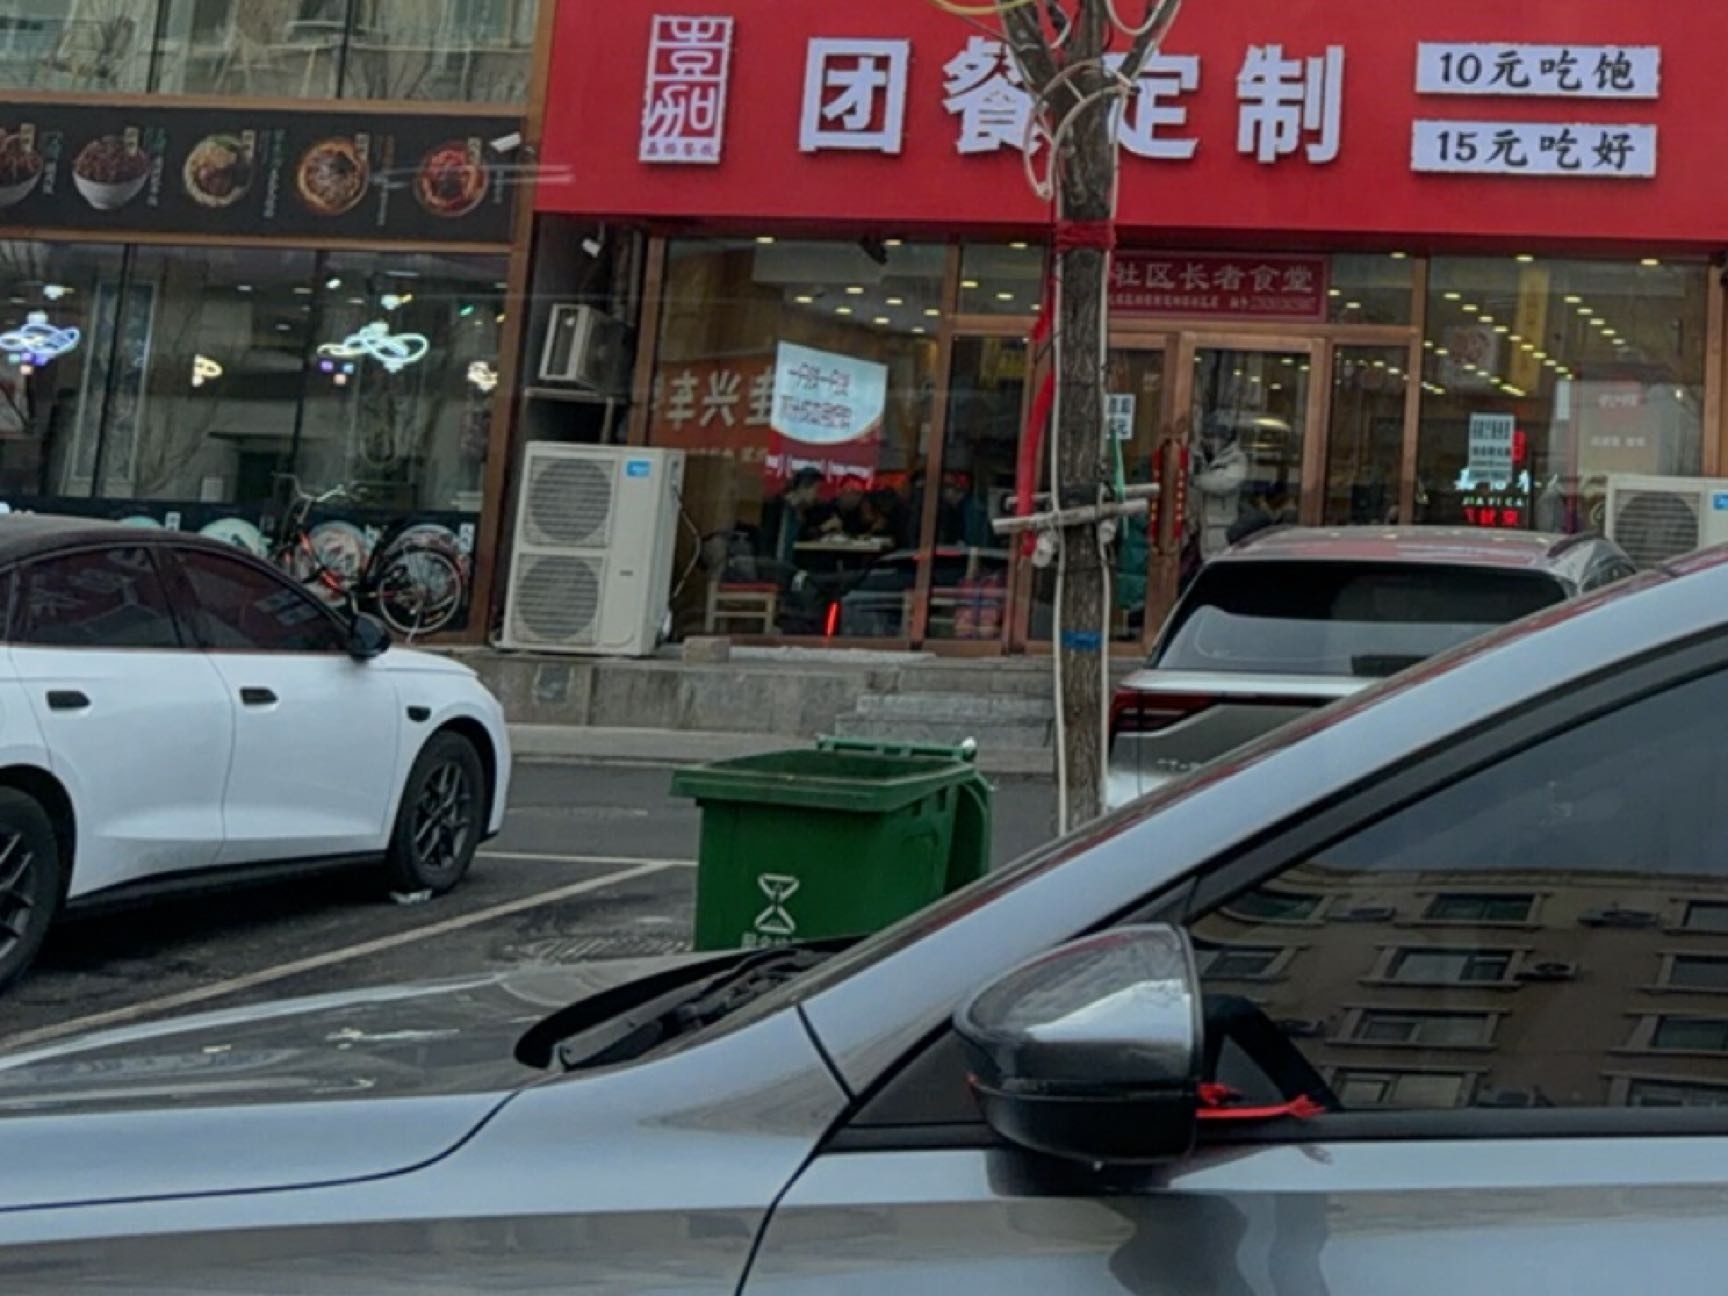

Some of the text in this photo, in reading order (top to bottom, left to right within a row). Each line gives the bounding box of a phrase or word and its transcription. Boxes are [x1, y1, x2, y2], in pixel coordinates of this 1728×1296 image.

[1439, 49, 1637, 91] 10元吃饱
[799, 35, 1344, 164] 团餐定制
[1437, 129, 1636, 170] 15元吃好
